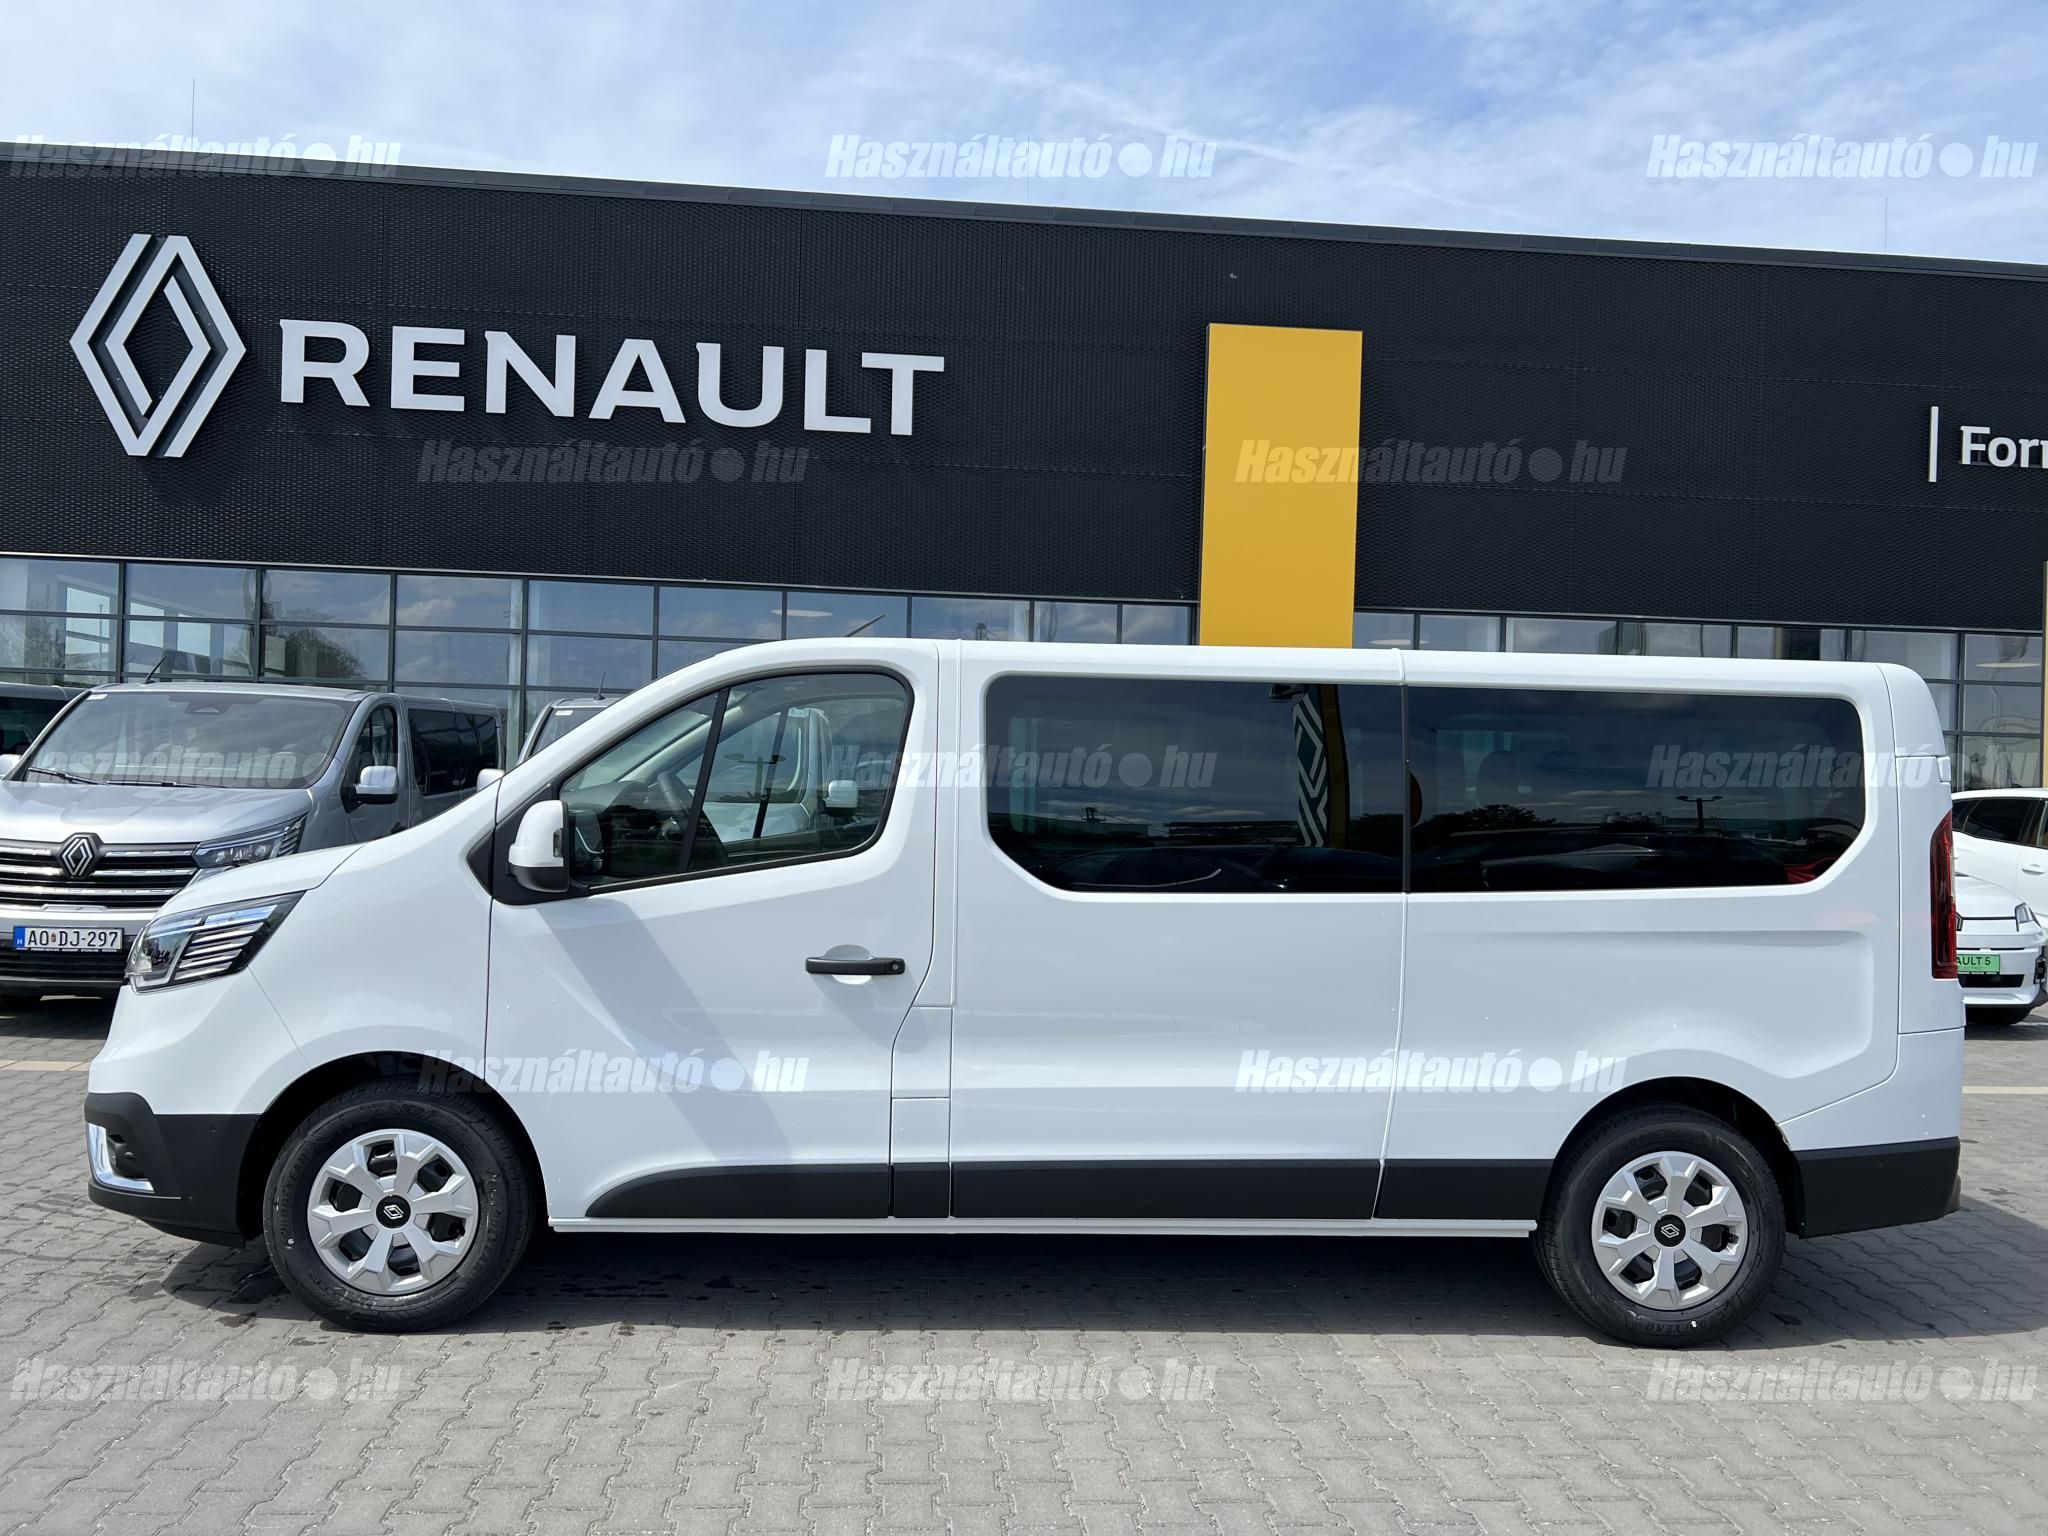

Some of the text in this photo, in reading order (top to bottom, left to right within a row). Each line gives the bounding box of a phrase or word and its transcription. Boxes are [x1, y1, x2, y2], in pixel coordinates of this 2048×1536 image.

[279, 317, 945, 437] RENAULT
[1957, 956, 1991, 965] AULT 5
